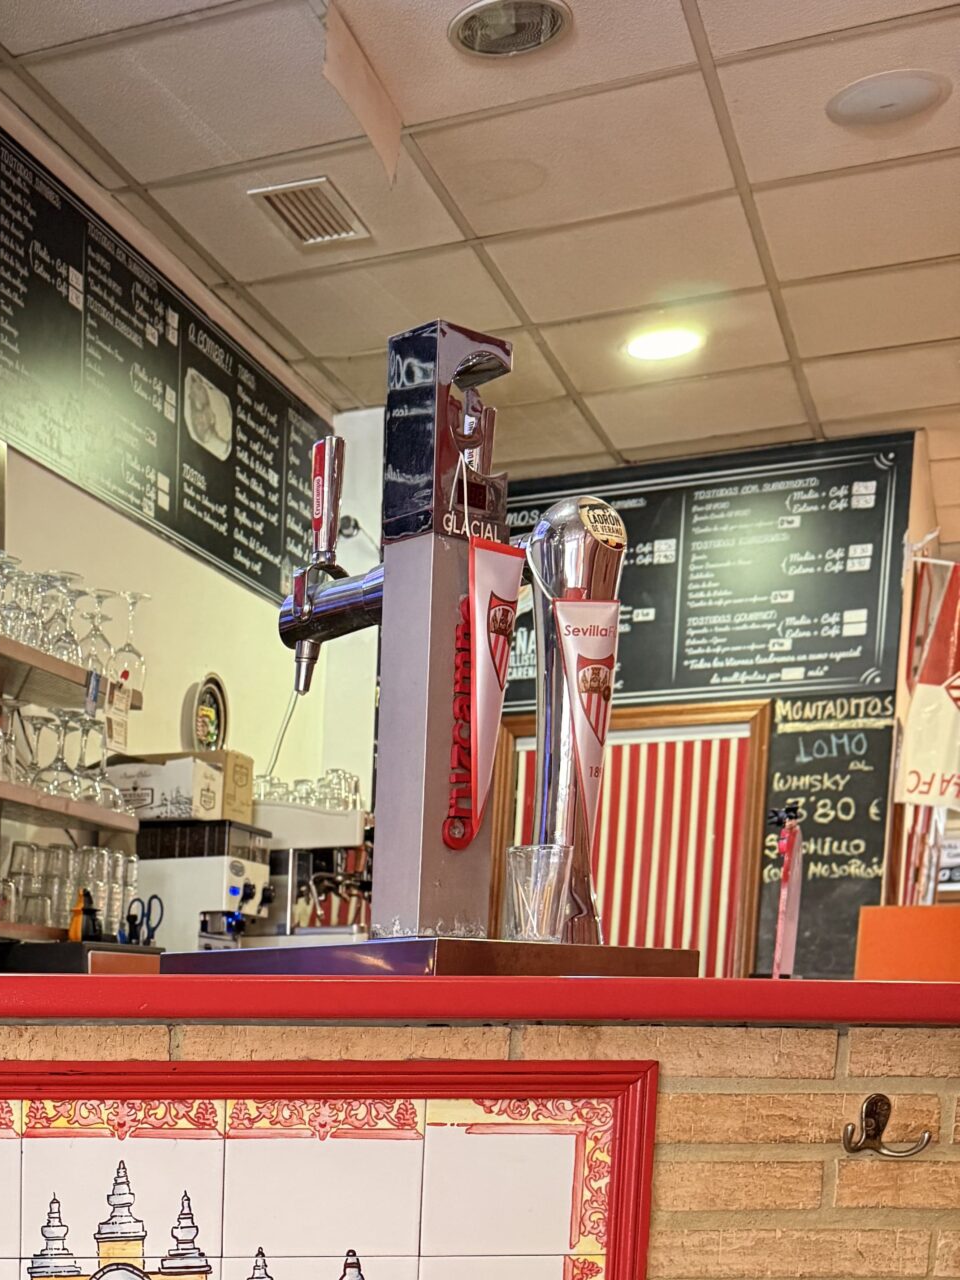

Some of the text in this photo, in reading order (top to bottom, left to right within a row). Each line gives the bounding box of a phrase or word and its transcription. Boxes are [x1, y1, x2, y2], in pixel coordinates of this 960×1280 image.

[313, 478, 322, 516] Cruzcampo
[828, 485, 849, 498] Café
[828, 498, 849, 511] Café
[442, 512, 502, 543] GLACIAL
[588, 511, 622, 528] LADRÓN
[825, 548, 845, 560] Café
[824, 561, 844, 573] Café
[820, 612, 841, 625] Café
[820, 625, 841, 638] Café
[774, 695, 895, 723] MONTADITOS
[795, 732, 869, 763] LOMO
[772, 771, 851, 792] WHISKY
[906, 769, 936, 794] FC
[869, 799, 882, 821] €
